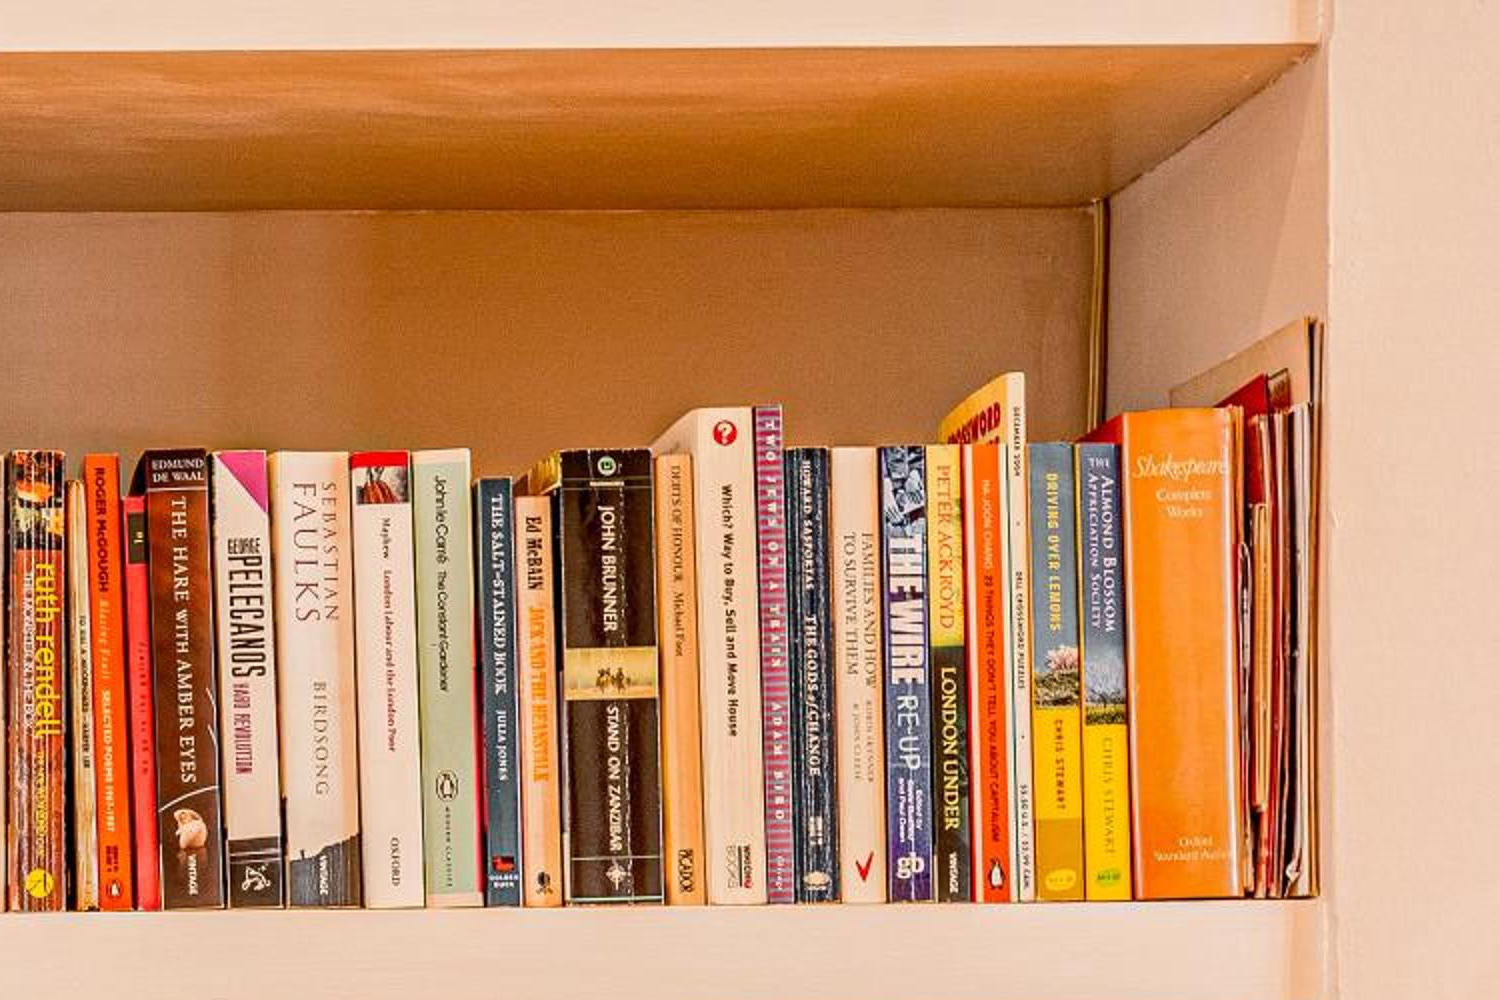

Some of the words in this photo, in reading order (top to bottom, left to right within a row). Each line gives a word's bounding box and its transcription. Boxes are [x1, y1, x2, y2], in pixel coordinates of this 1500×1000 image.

[94, 468, 106, 516] ROGER
[172, 496, 188, 538] THE
[490, 494, 503, 528] THE
[721, 485, 734, 530] Which?
[936, 465, 953, 524] PETER
[1046, 473, 1058, 529] DRIVING
[1100, 474, 1114, 549] ALMOND
[96, 520, 108, 592] McGOUGH
[293, 482, 320, 622] FAULKS
[322, 482, 338, 621] SEBASTIAN
[598, 506, 616, 550] JOHN
[720, 534, 734, 558] Way
[1048, 536, 1059, 570] OVER
[36, 563, 60, 621] ruth
[173, 547, 190, 601] HARE
[492, 531, 506, 647] SALT-STAINED
[602, 555, 617, 632] BRUNNER
[722, 579, 734, 606] Buy,
[724, 562, 735, 576] to
[889, 534, 924, 598] THE
[939, 531, 955, 629] ACKROYD
[228, 556, 266, 677] PELECANOS
[726, 610, 737, 633] Sell
[1049, 576, 1060, 632] LEMONS
[1104, 557, 1116, 632] BLOSSOM
[174, 609, 188, 653] WITH
[726, 637, 738, 658] and
[890, 600, 925, 684] WIRE
[34, 636, 60, 736] rendell
[176, 660, 194, 730] AMBER
[493, 652, 506, 696] BOOK
[726, 662, 738, 694] Move
[312, 682, 329, 795] BIRDSONG
[607, 706, 620, 750] STAND
[728, 700, 739, 736] House
[896, 695, 920, 771] RE-UP
[940, 668, 956, 753] LONDON
[180, 736, 196, 782] EYES
[608, 757, 621, 779] ON
[608, 785, 623, 851] ZANZIBAR
[943, 759, 959, 831] UNDER
[188, 854, 198, 895] VINTAGE
[678, 849, 693, 892] PICADOR
